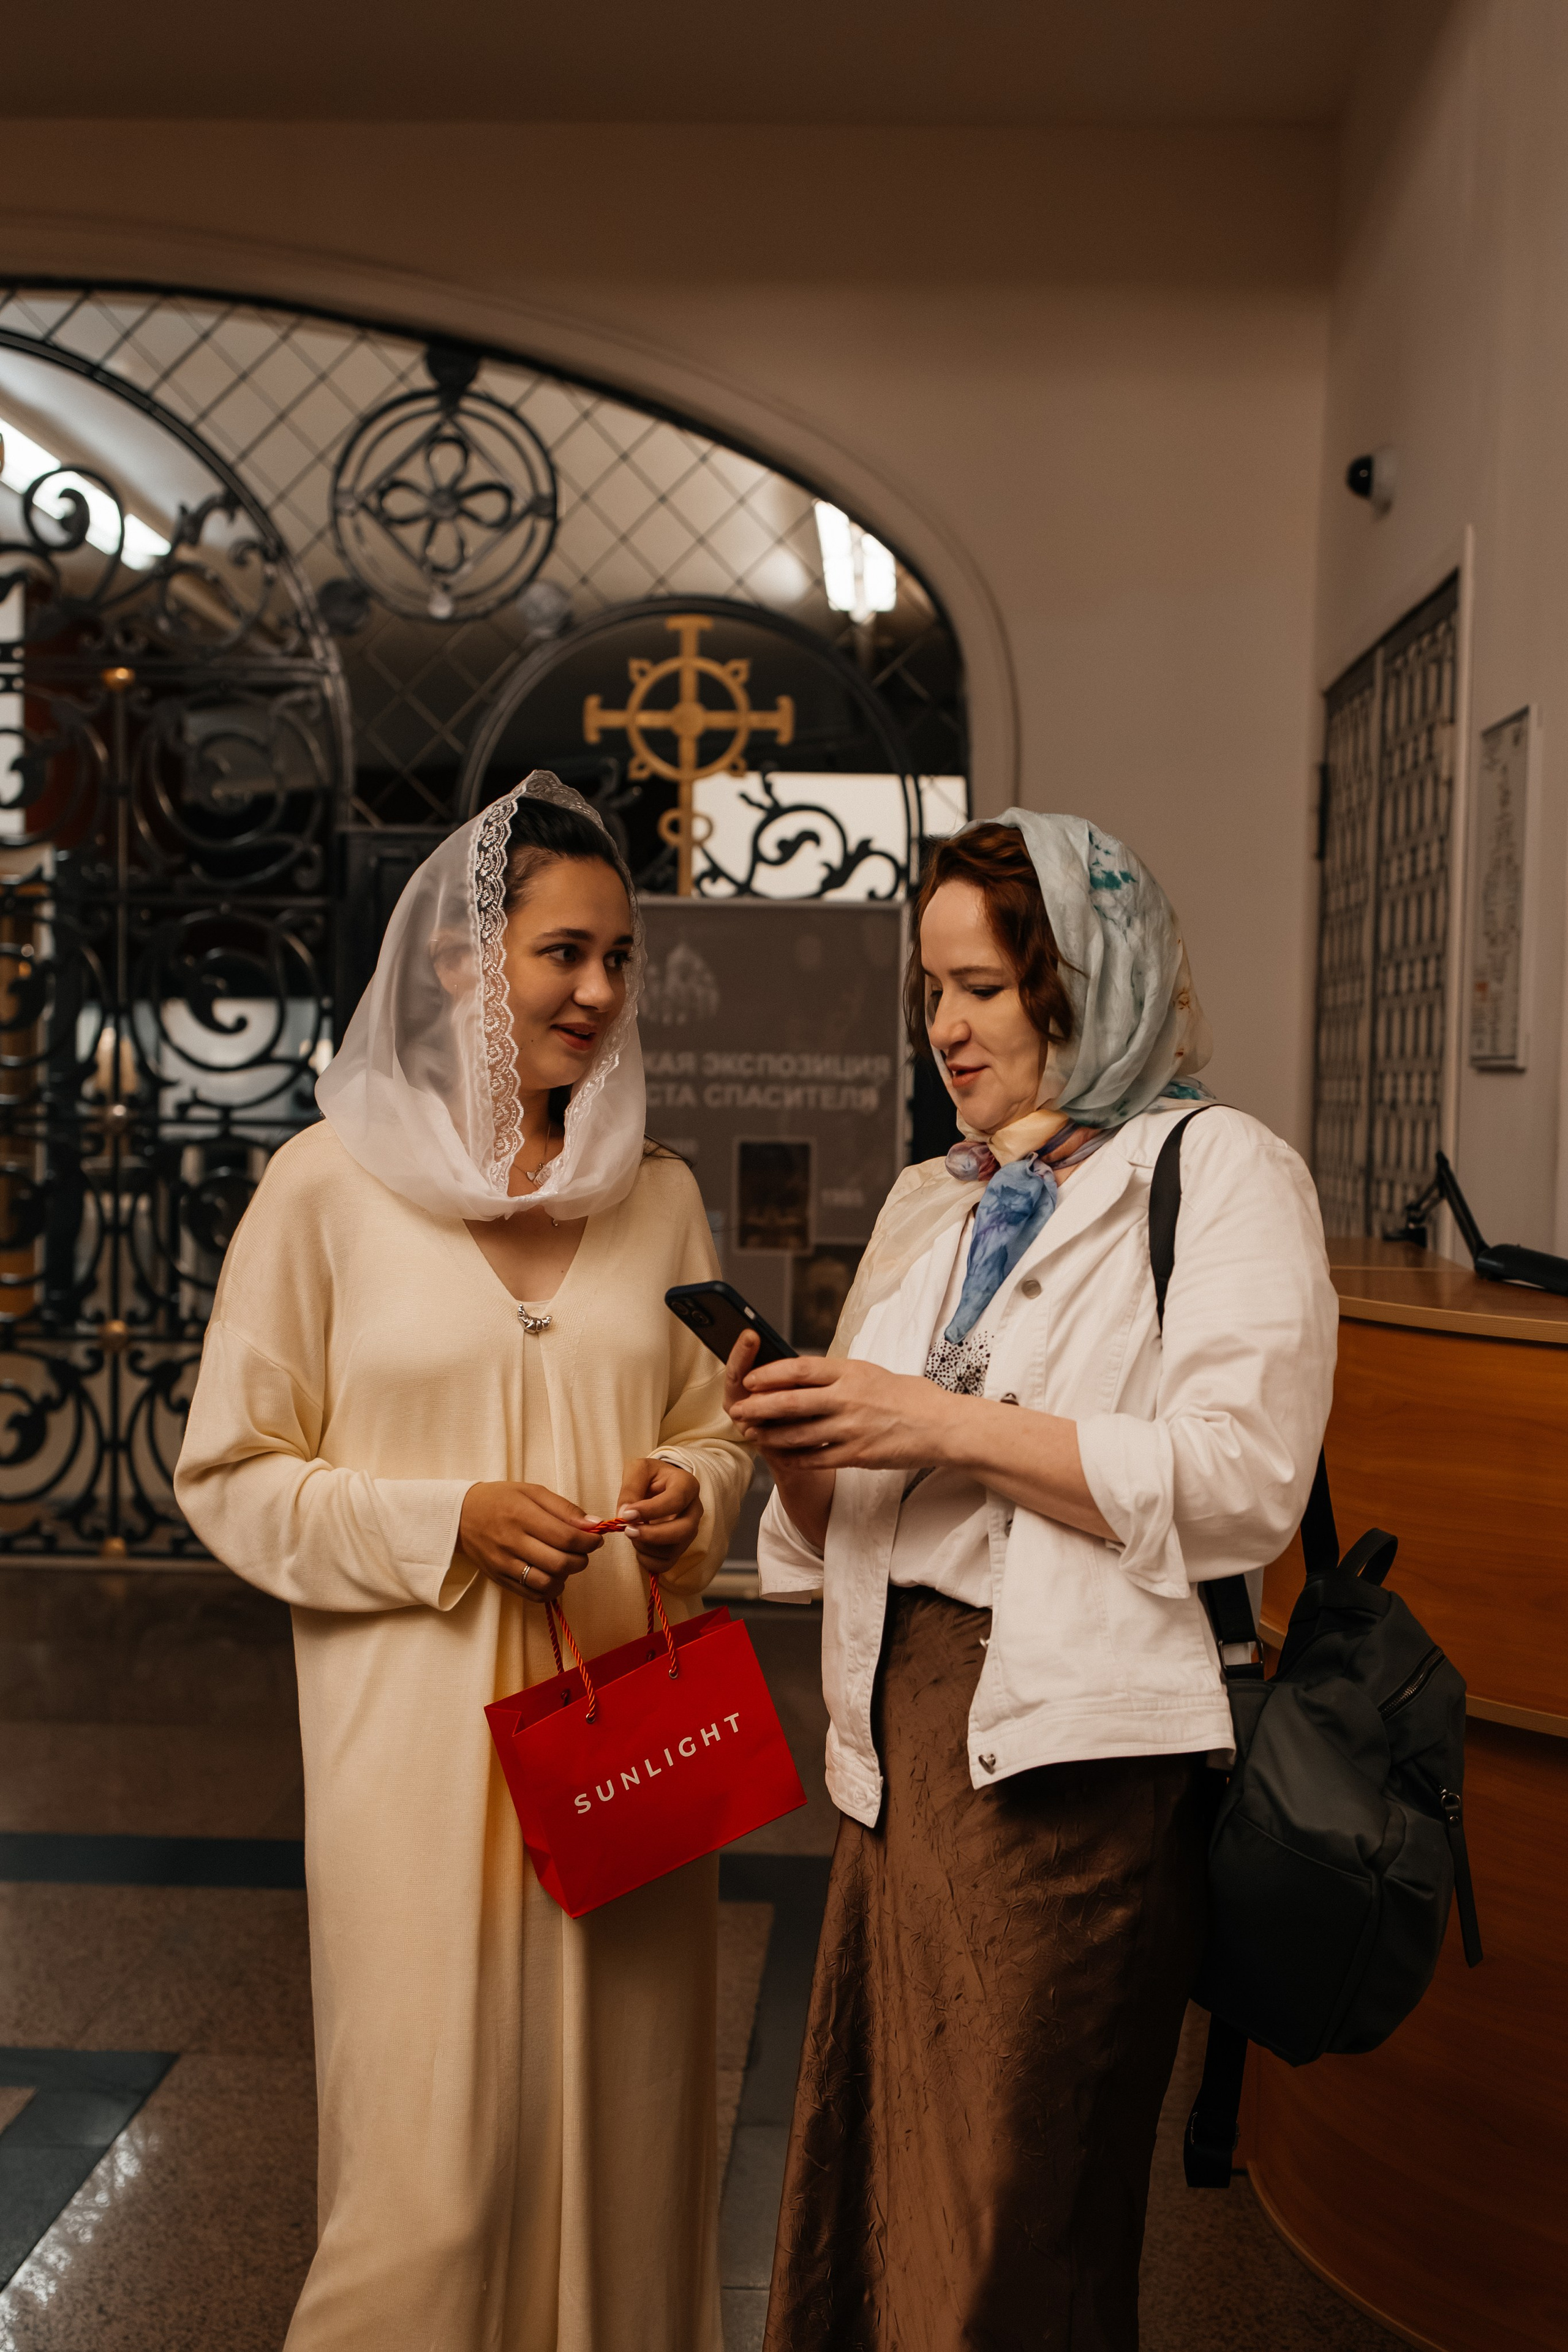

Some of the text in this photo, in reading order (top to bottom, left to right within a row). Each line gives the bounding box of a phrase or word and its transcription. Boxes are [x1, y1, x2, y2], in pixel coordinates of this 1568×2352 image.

[703, 1052, 890, 1080] ЭКСПОЗИЦИЯ
[703, 1084, 879, 1112] СПАСИТЕЛЯ
[574, 1713, 739, 1814] SUNLIGHT
